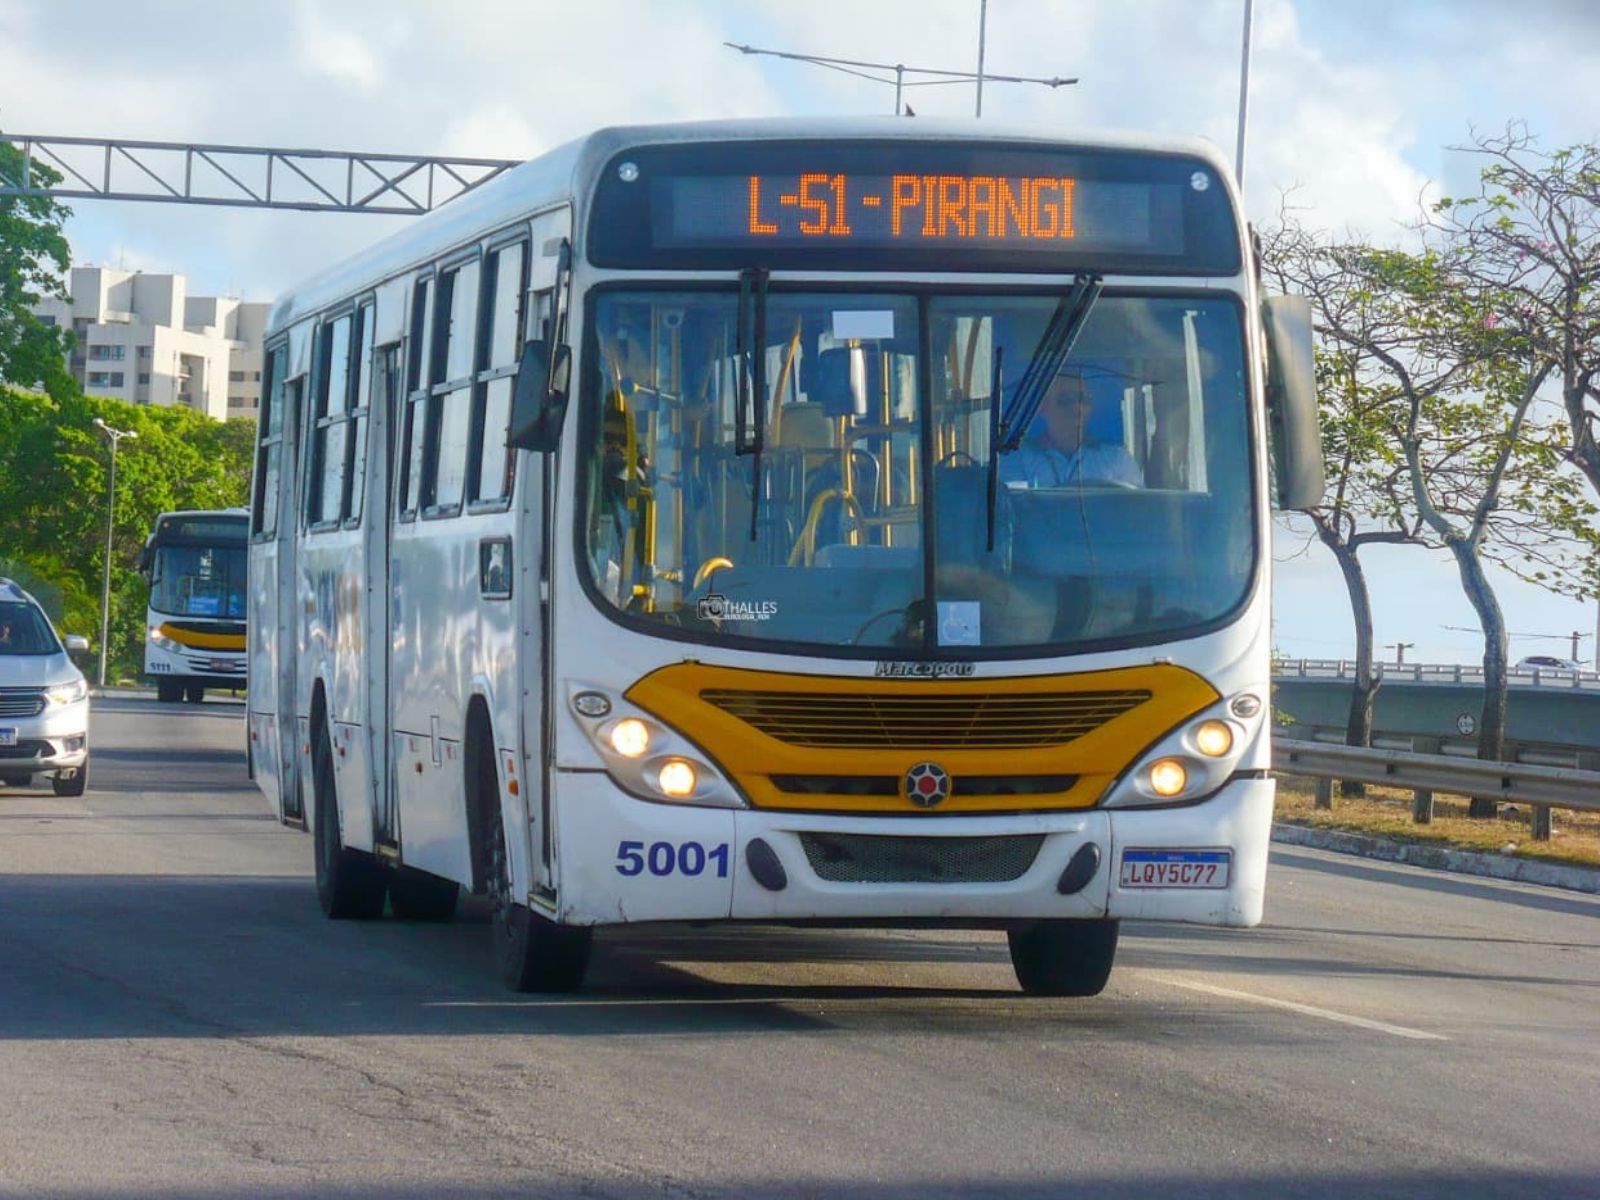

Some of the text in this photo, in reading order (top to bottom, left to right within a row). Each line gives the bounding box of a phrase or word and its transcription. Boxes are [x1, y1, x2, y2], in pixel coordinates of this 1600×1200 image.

[749, 173, 851, 235] L-51
[892, 174, 1075, 238] PIRANGI
[875, 661, 976, 677] Marcopolo
[615, 841, 729, 878] 5001
[1131, 863, 1217, 883] LQY5C77
